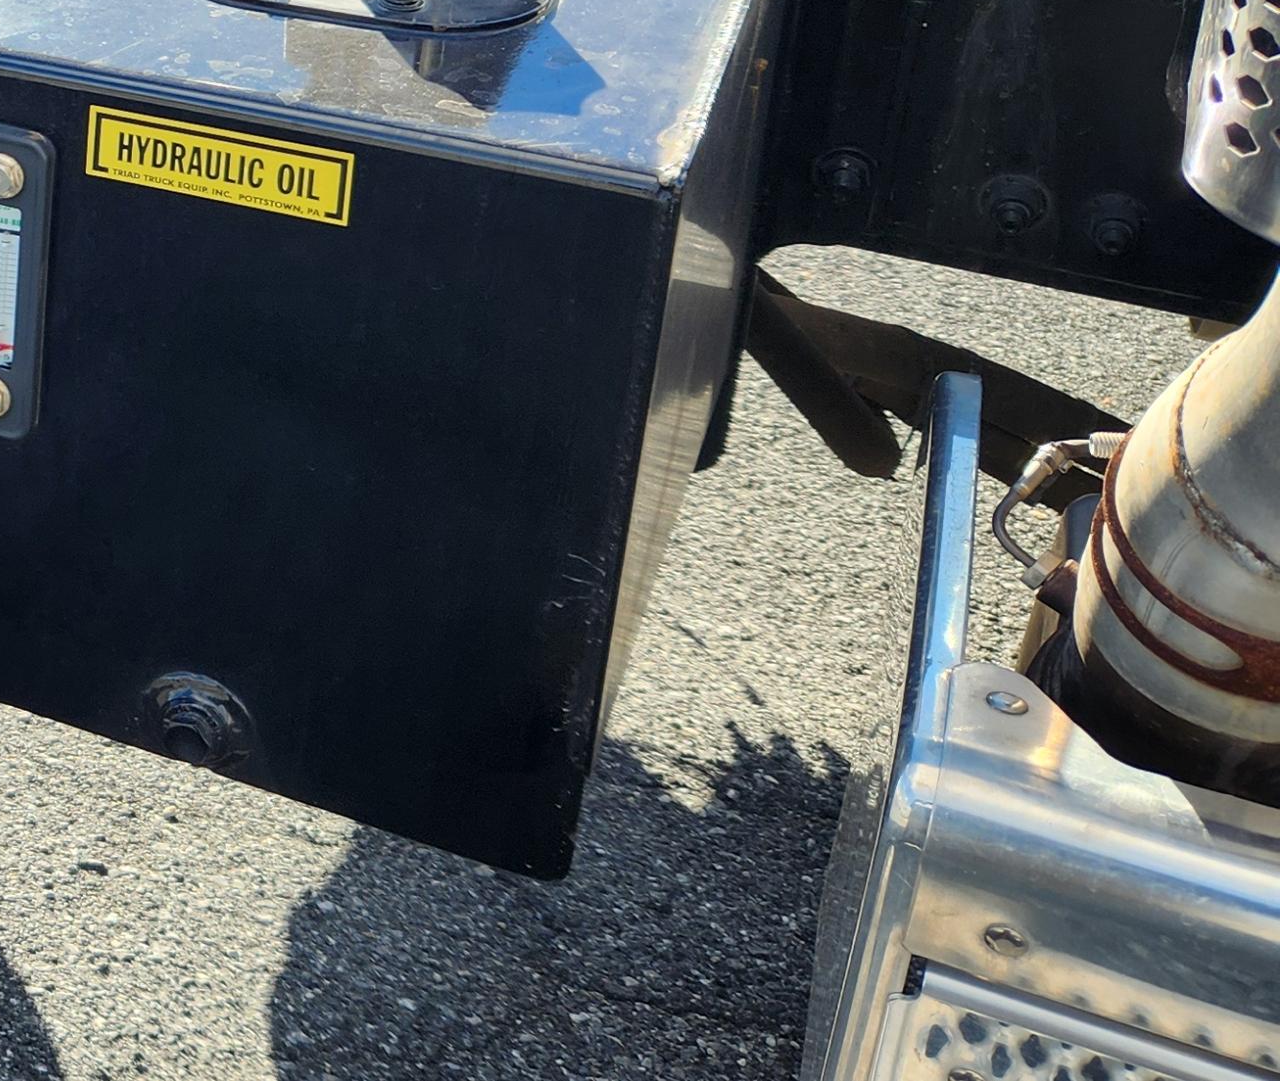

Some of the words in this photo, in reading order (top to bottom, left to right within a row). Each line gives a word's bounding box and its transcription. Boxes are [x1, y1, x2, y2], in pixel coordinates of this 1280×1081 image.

[112, 168, 141, 180] TRIAD
[143, 174, 175, 187] TRUCK
[211, 188, 233, 199] INC.
[238, 193, 305, 215] POTTSTOWN,
[118, 131, 265, 189] HYDRAULIC
[277, 163, 320, 201] OIL
